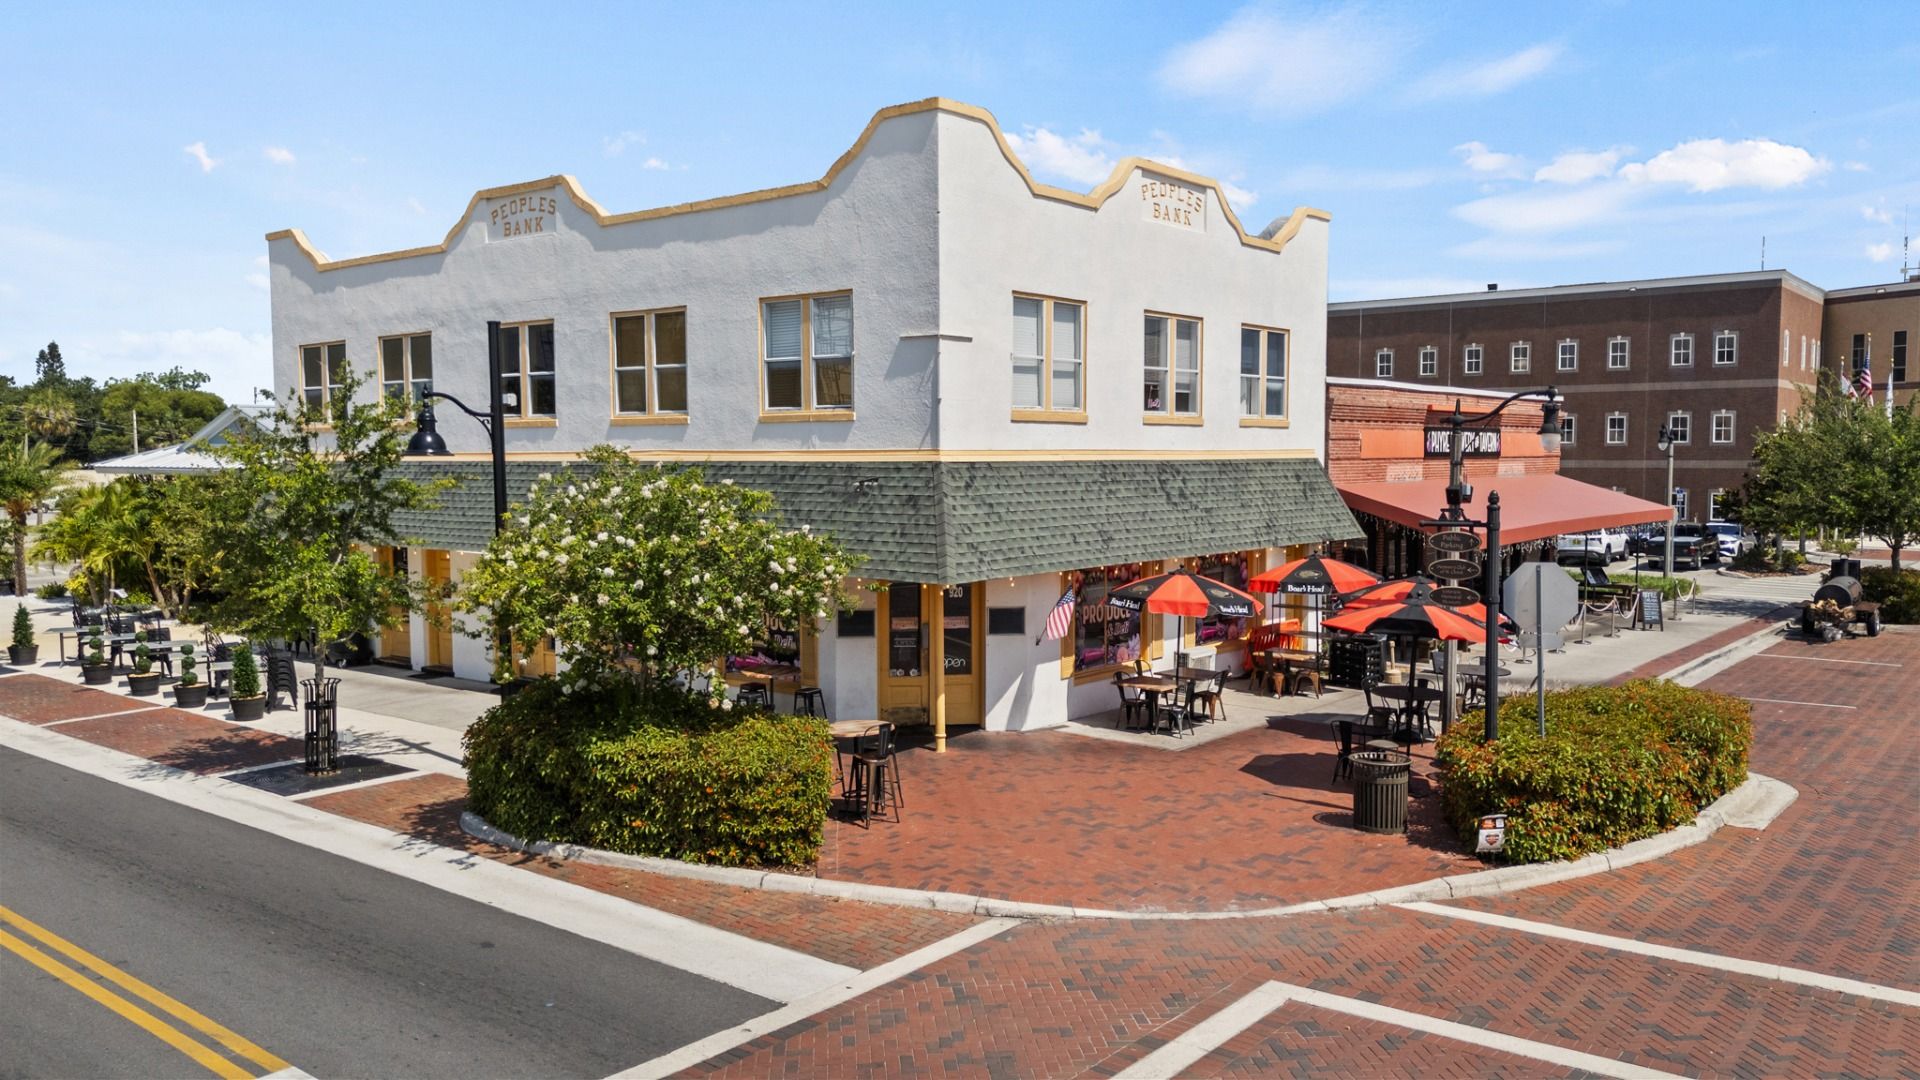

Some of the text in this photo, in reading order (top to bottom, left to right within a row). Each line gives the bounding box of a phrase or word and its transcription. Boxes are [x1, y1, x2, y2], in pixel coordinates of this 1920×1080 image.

[1141, 182, 1202, 213] PEOPLES
[491, 196, 557, 225] PEOPLES
[1153, 202, 1191, 226] BANK
[503, 217, 543, 237] BANK
[1440, 541, 1464, 550] Parking
[948, 586, 963, 598] 920
[1307, 584, 1325, 593] Head
[943, 657, 966, 669] pen
